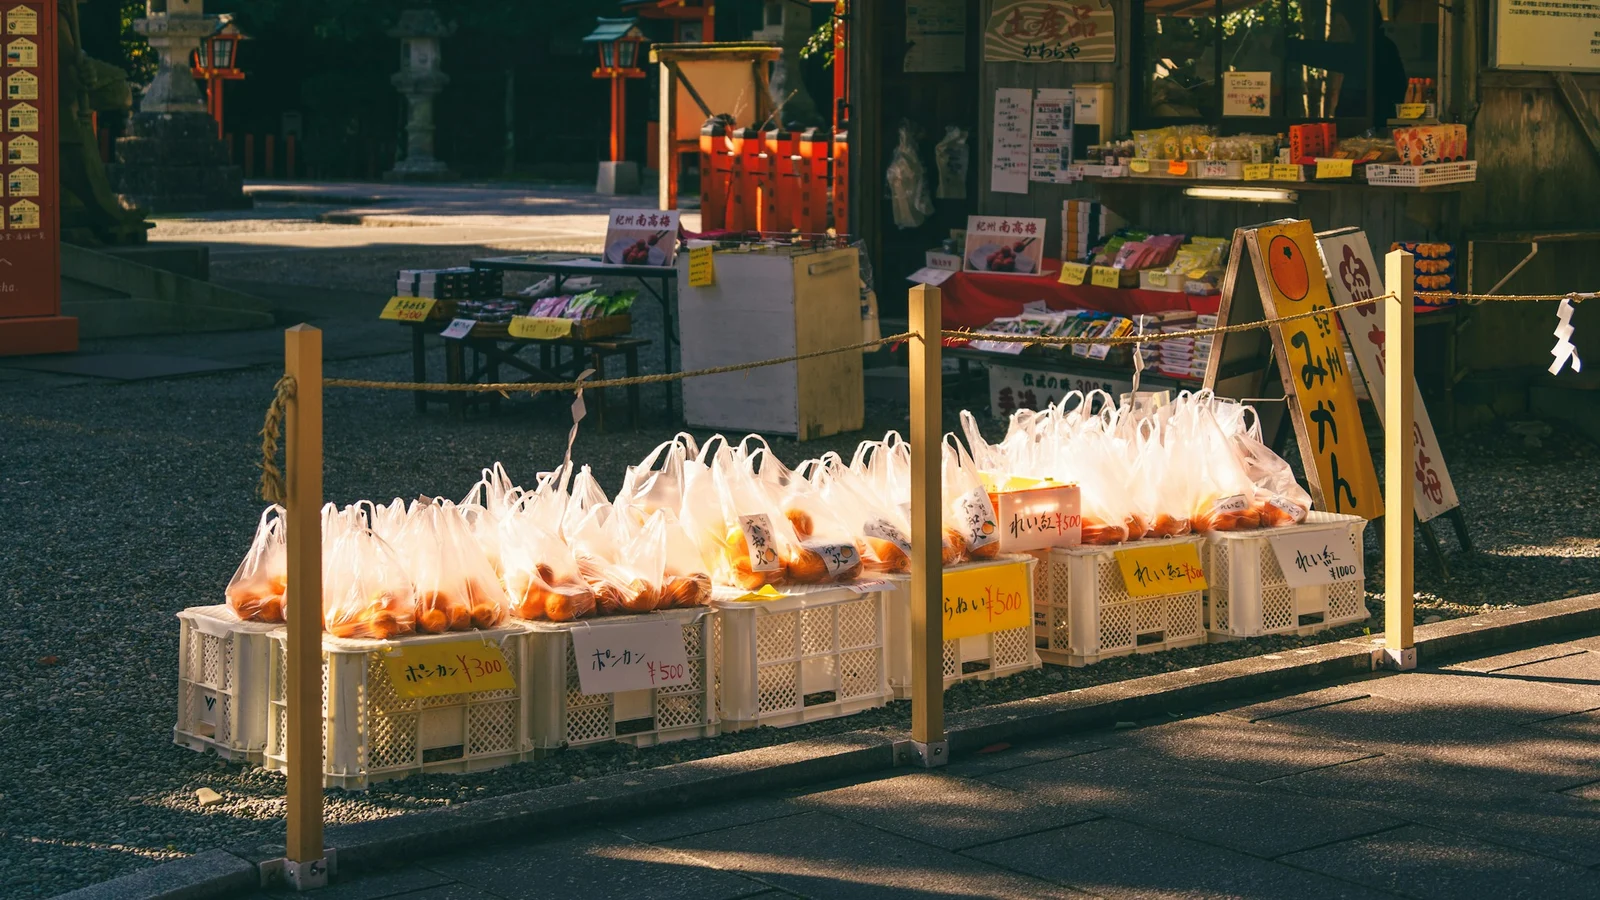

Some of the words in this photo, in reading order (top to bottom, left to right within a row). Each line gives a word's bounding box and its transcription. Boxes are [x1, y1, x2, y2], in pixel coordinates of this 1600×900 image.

[1023, 42, 1080, 59] かわらや
[615, 215, 634, 226] 紀州
[636, 213, 671, 228] 南高梅
[976, 221, 996, 232] 紀州
[999, 221, 1038, 234] 南高梅
[1291, 331, 1357, 514] みかん
[962, 499, 986, 545] 不知火
[1010, 511, 1056, 539] れい紅
[1055, 512, 1081, 536] ¥500
[746, 519, 768, 566] 不知火
[1134, 560, 1185, 588] れい紅
[1295, 545, 1340, 573] れい紅
[1329, 564, 1356, 580] ¥1000
[944, 597, 985, 621] らぬい
[985, 584, 1022, 623] ¥500
[405, 663, 458, 682] ポンカン
[456, 654, 502, 683] ¥300
[592, 649, 645, 671] ポンカン
[647, 660, 684, 685] ¥500
